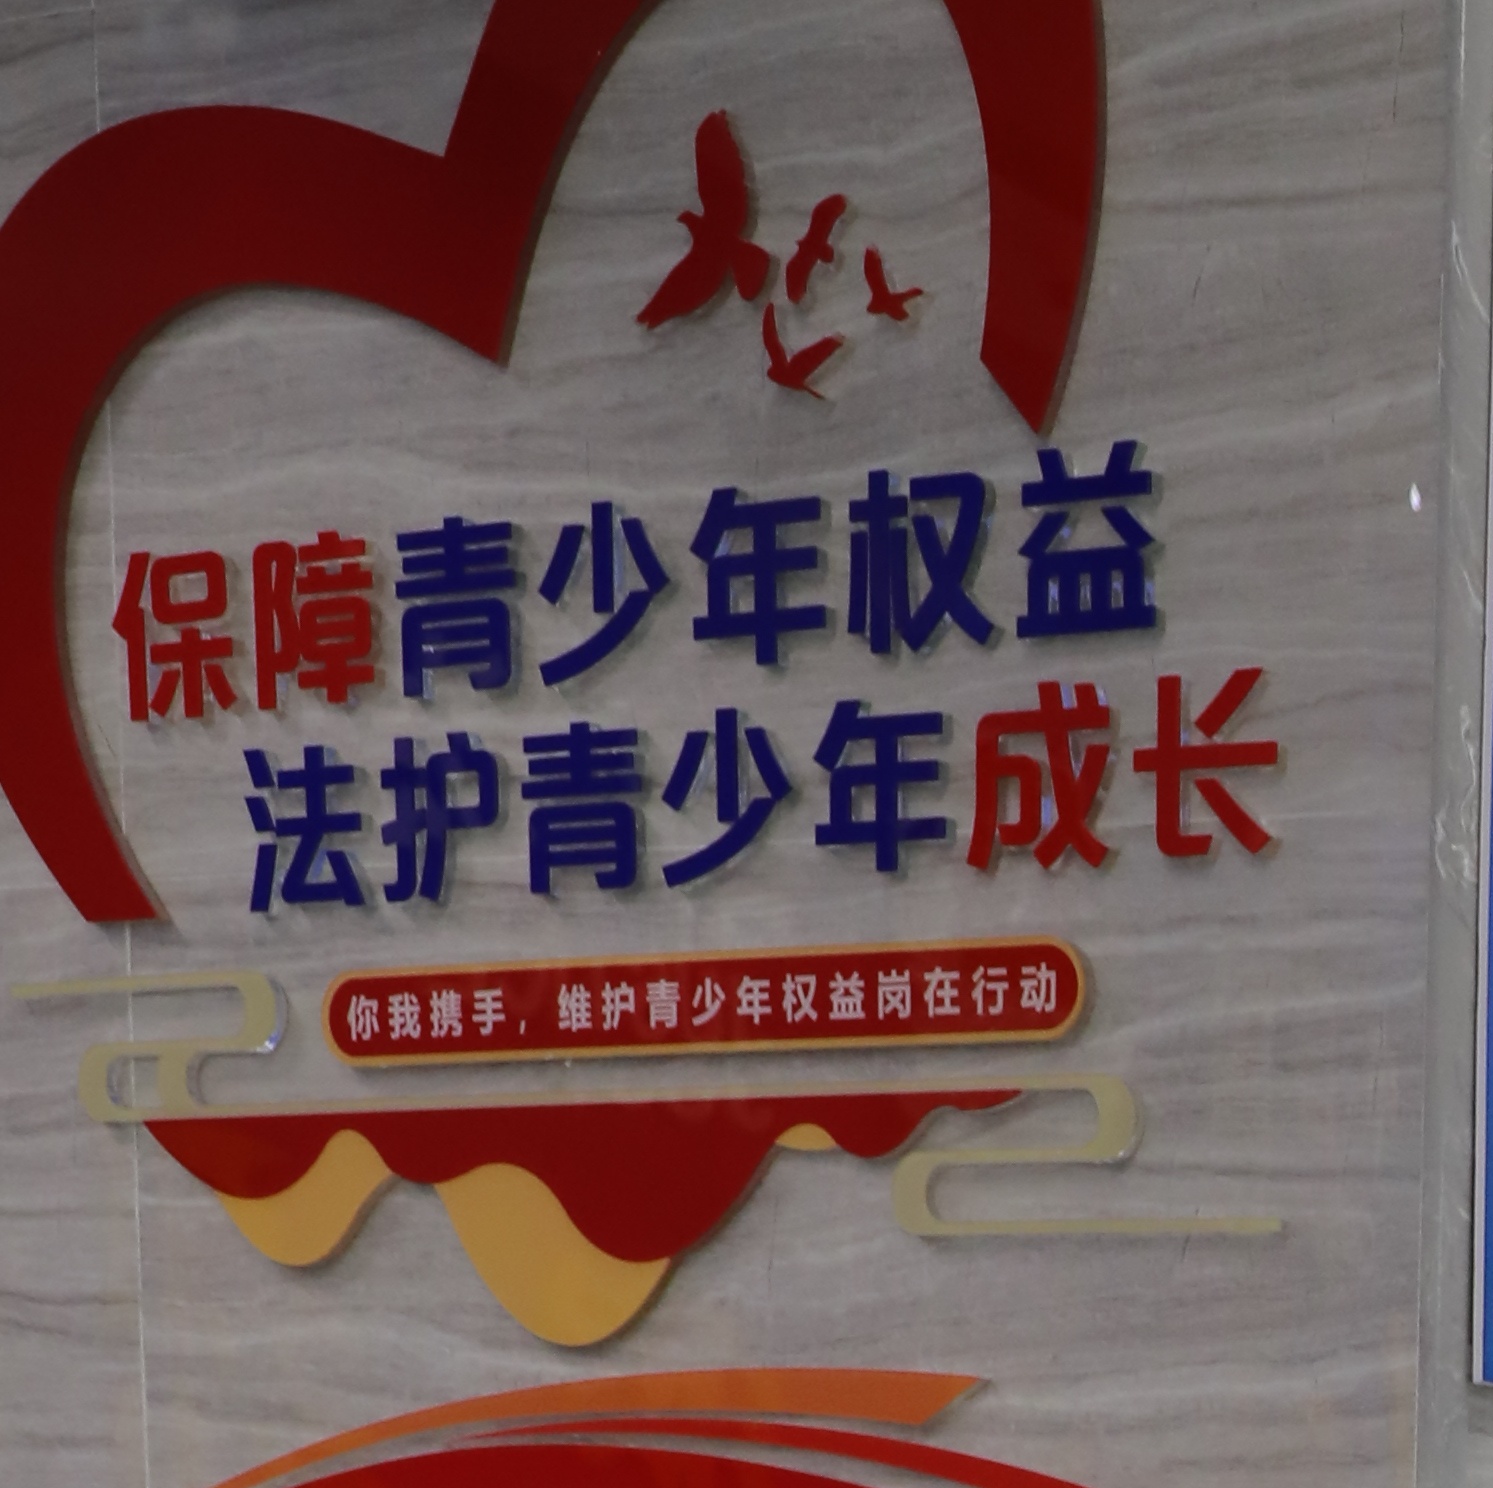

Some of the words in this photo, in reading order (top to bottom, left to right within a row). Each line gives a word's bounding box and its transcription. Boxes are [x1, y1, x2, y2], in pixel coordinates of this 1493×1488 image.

[111, 441, 1160, 723] 保障青少年权益
[243, 668, 1278, 912] 法护青少年成长
